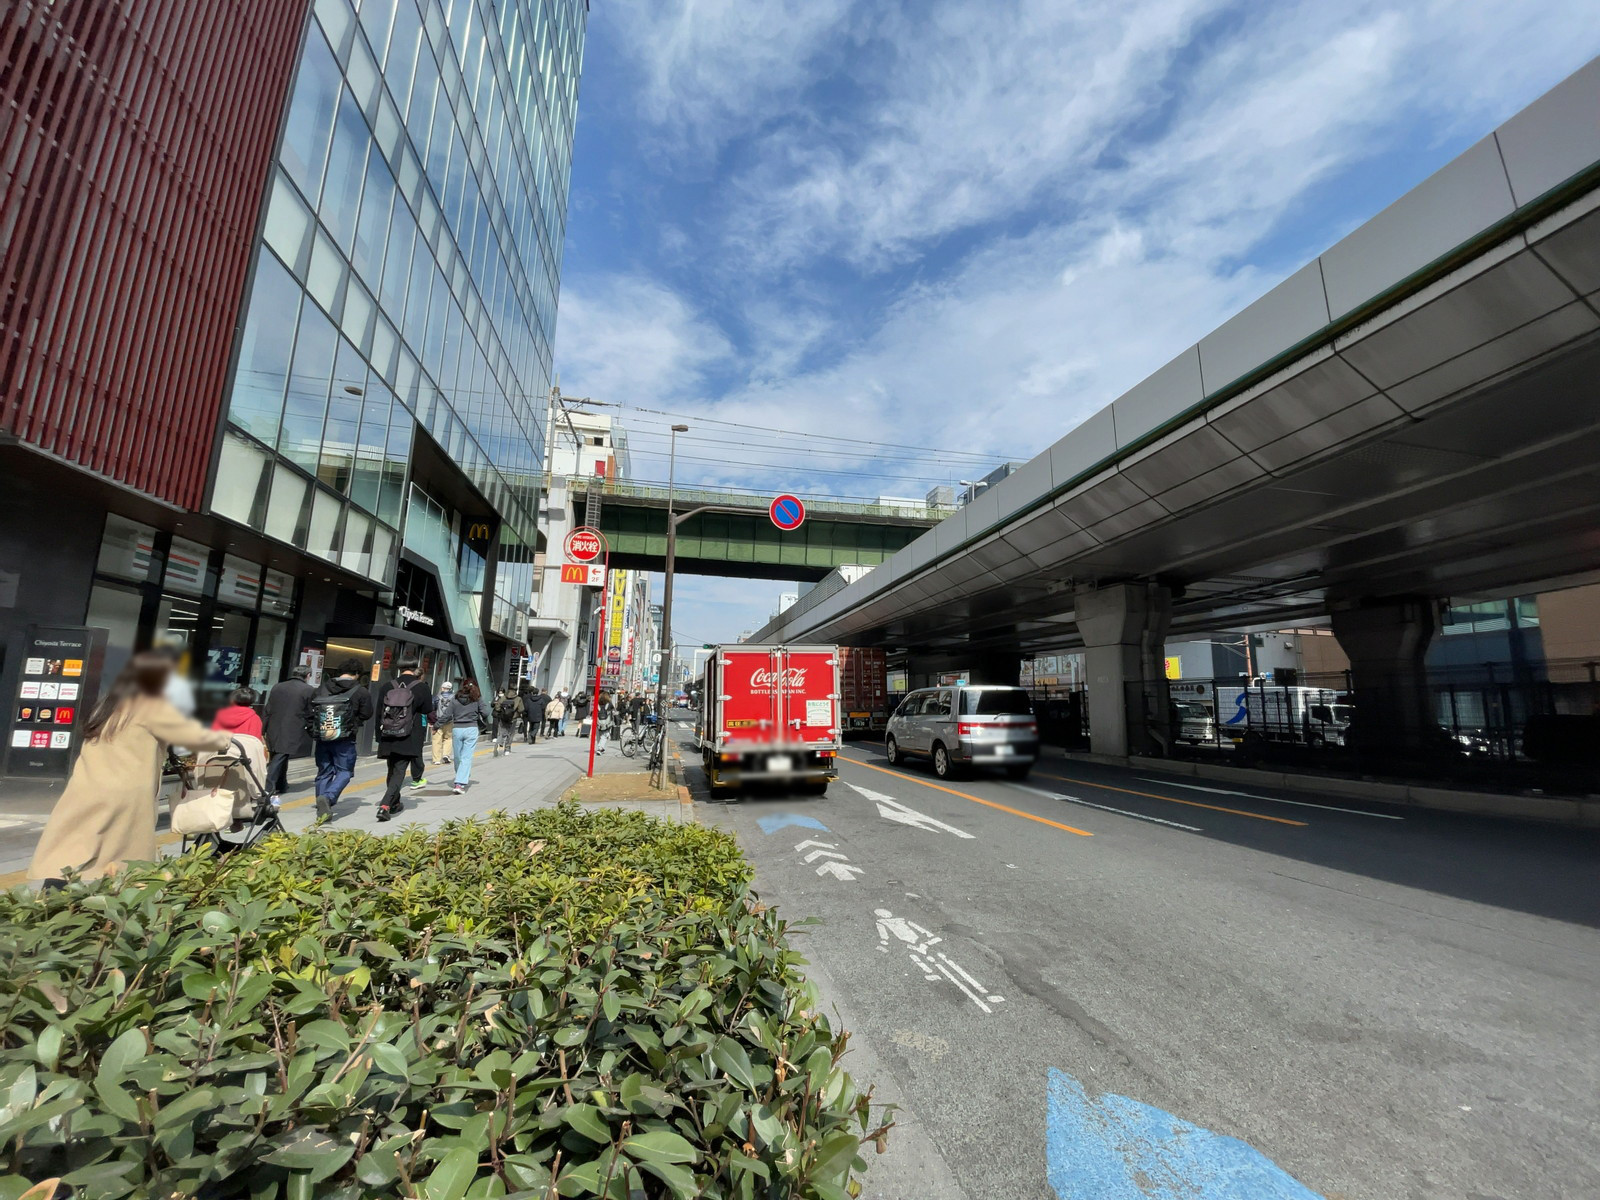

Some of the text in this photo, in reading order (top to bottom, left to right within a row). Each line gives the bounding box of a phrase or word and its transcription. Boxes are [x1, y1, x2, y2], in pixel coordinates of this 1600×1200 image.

[572, 540, 598, 552] 消火栓
[750, 667, 808, 687] CocaCola
[326, 705, 334, 730] NORTH
